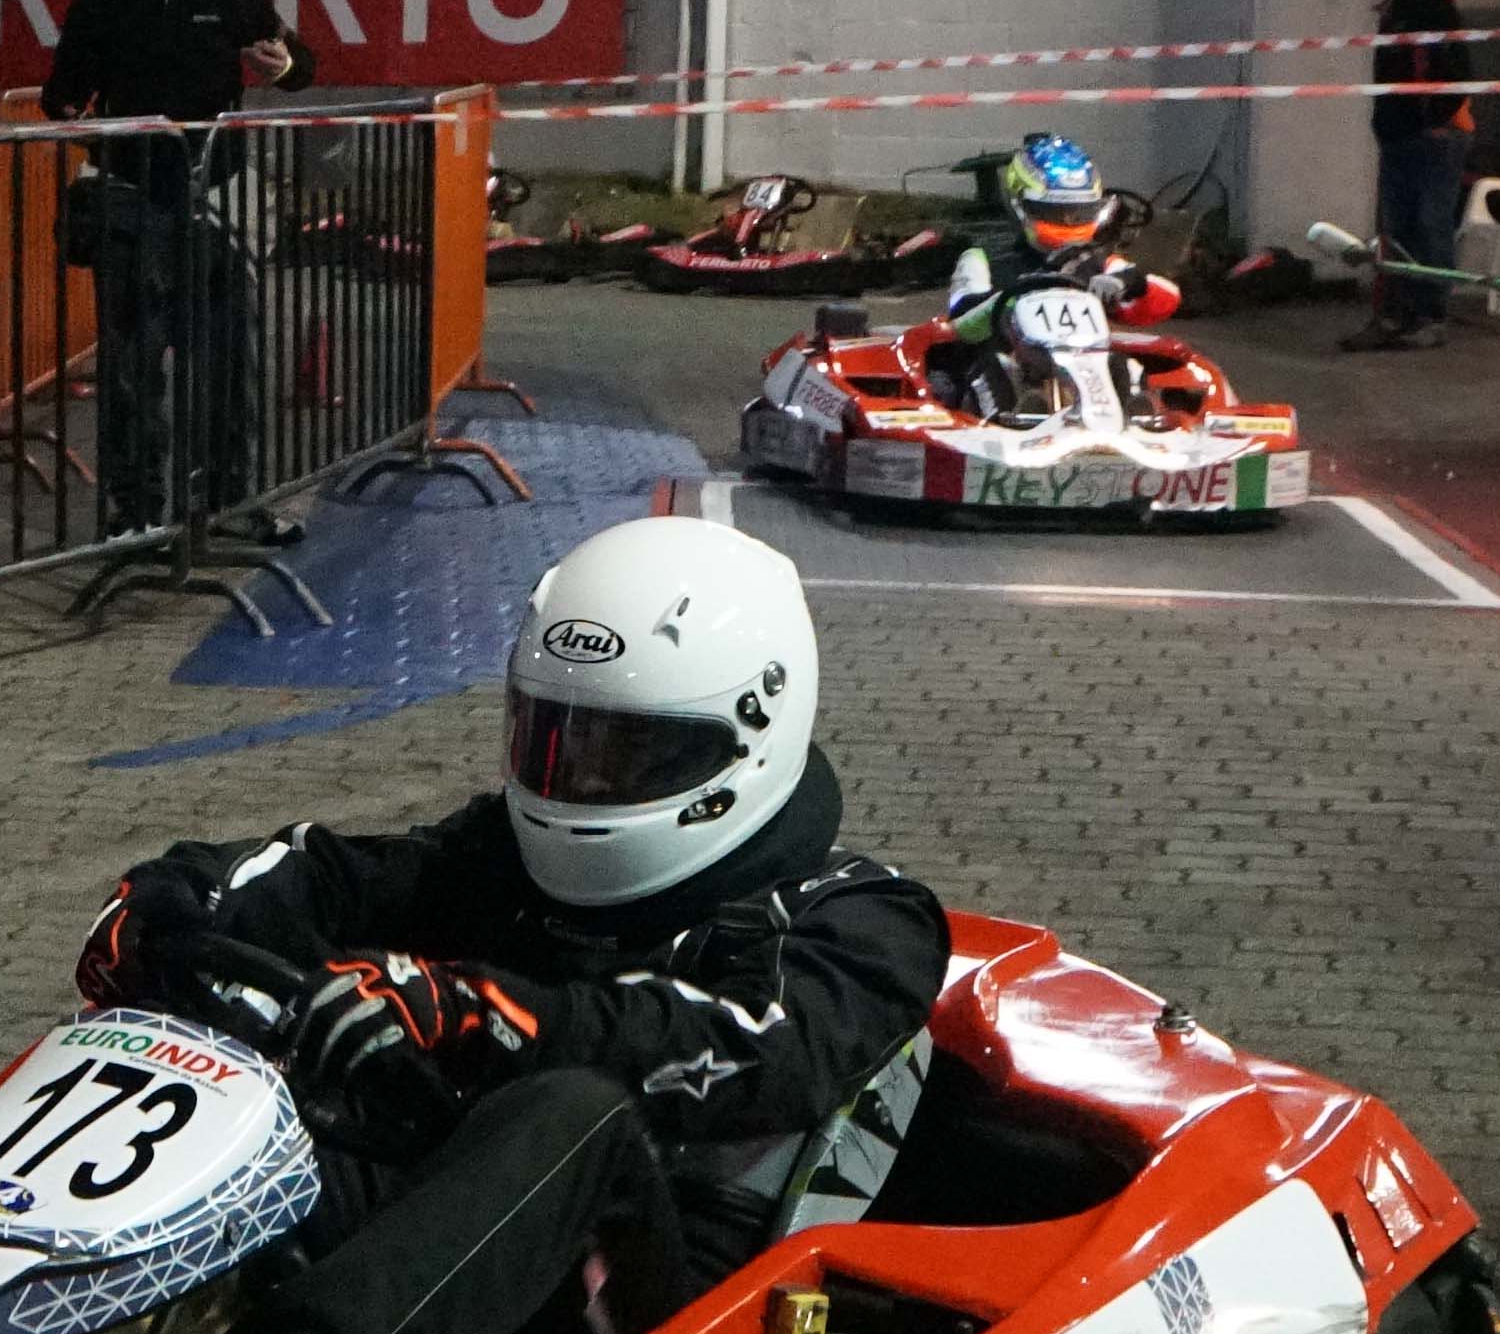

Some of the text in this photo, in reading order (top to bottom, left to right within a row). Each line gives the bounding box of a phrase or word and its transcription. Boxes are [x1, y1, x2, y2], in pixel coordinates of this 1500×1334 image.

[1034, 302, 1101, 335] 141
[545, 623, 614, 654] Arai
[60, 1026, 243, 1084] EUROINDY
